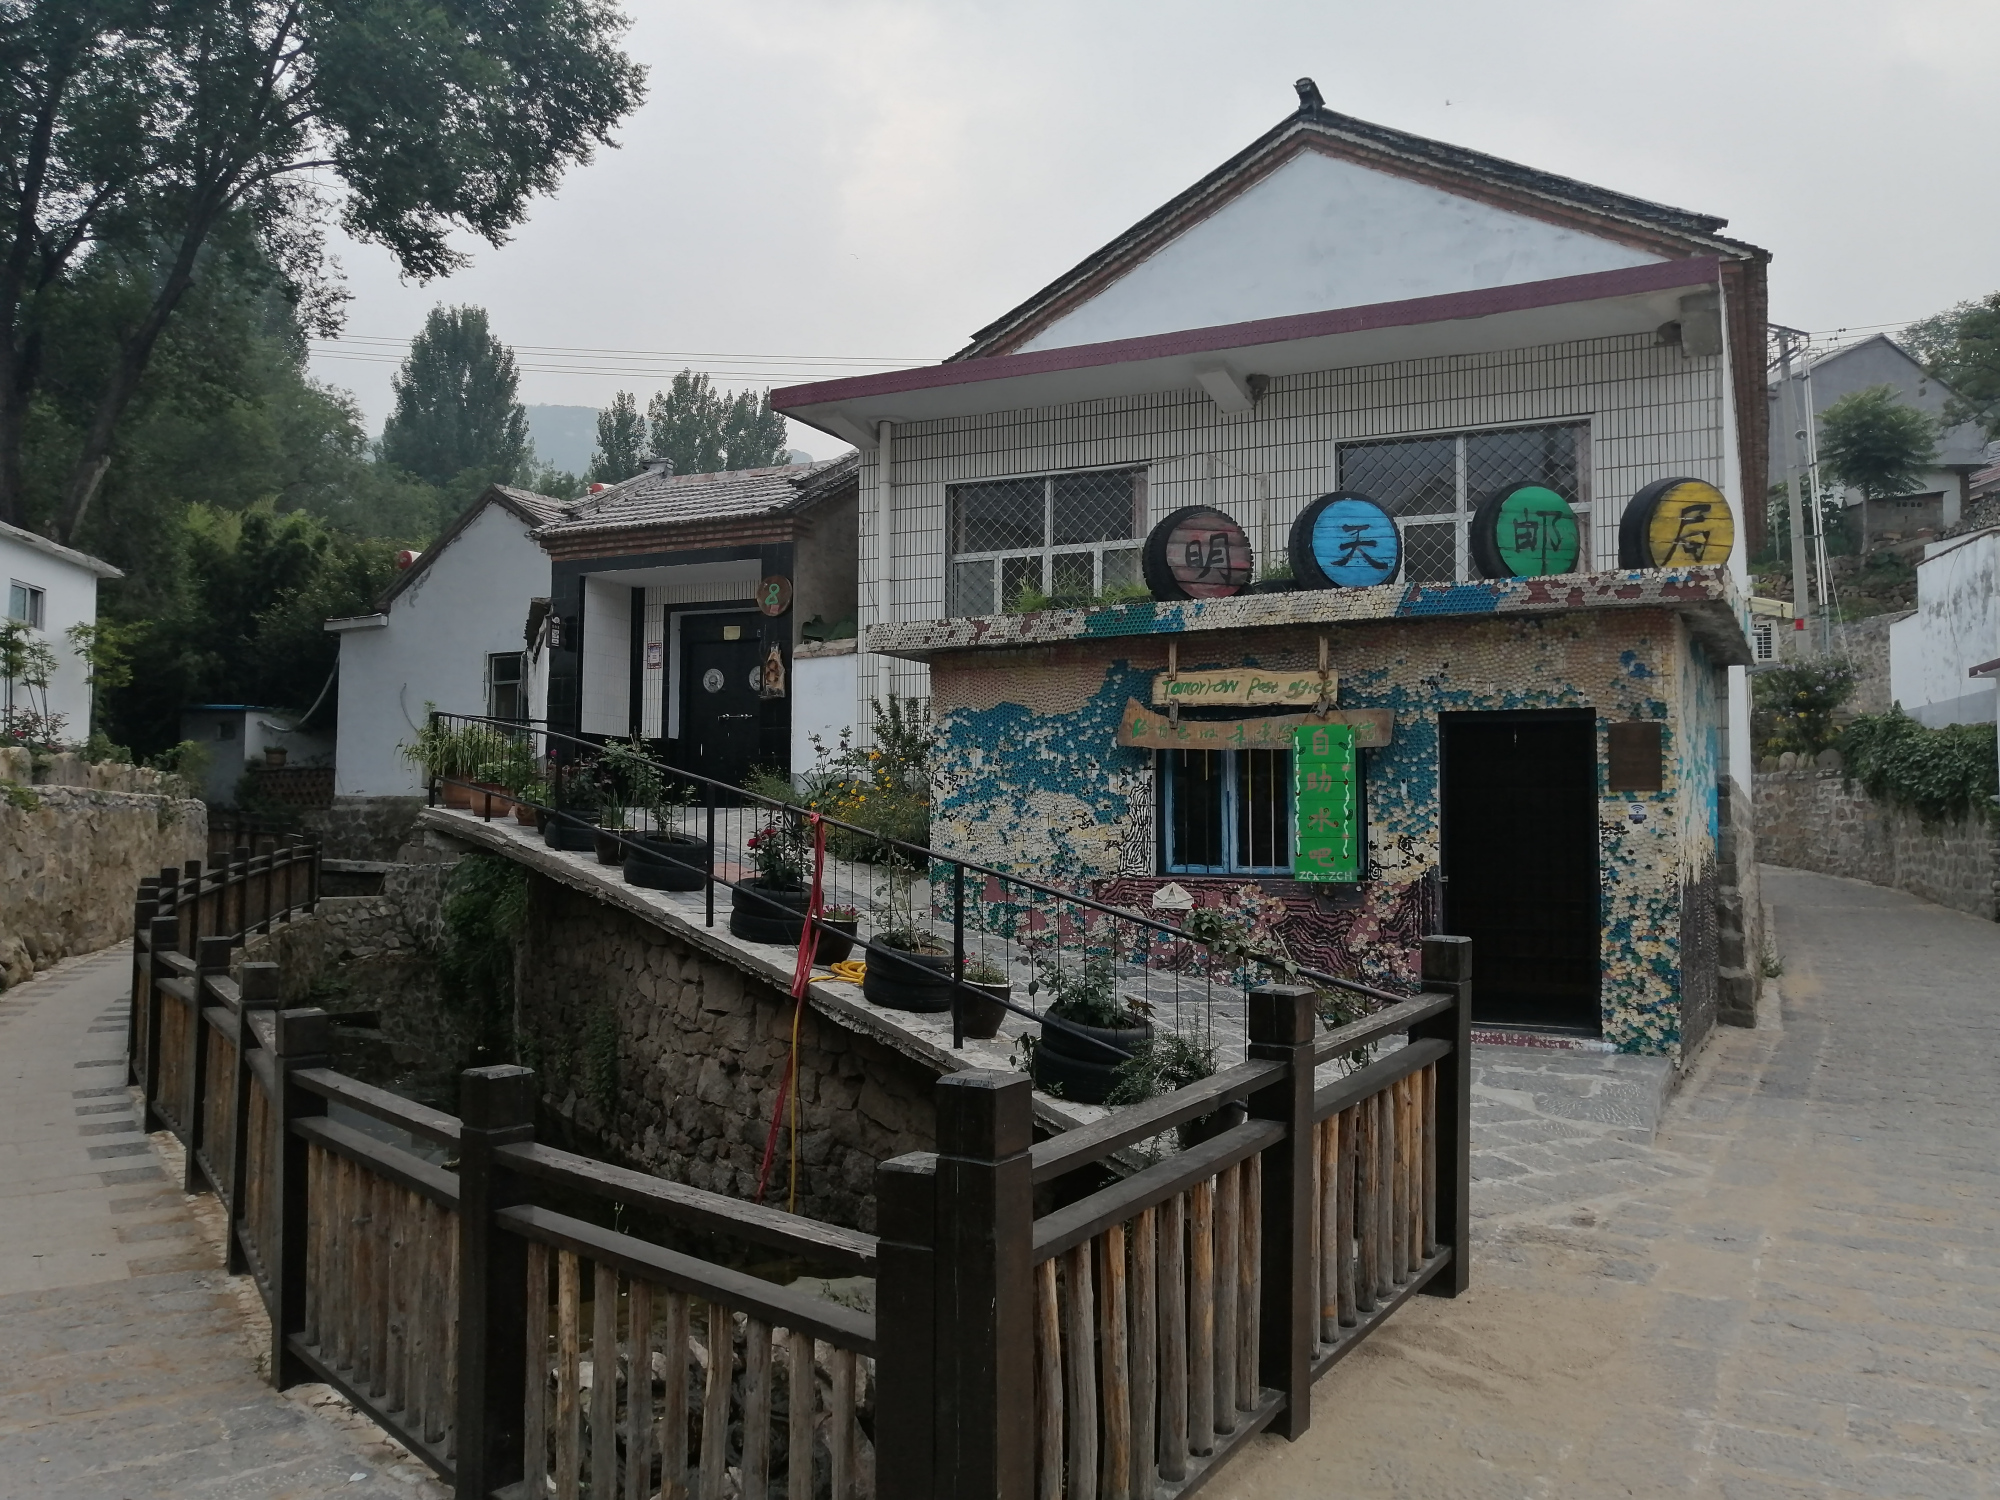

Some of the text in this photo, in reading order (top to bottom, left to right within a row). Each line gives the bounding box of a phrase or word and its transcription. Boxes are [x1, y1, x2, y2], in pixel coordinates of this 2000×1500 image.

[765, 583, 780, 606] 8
[1306, 729, 1337, 867] 自助水吧
